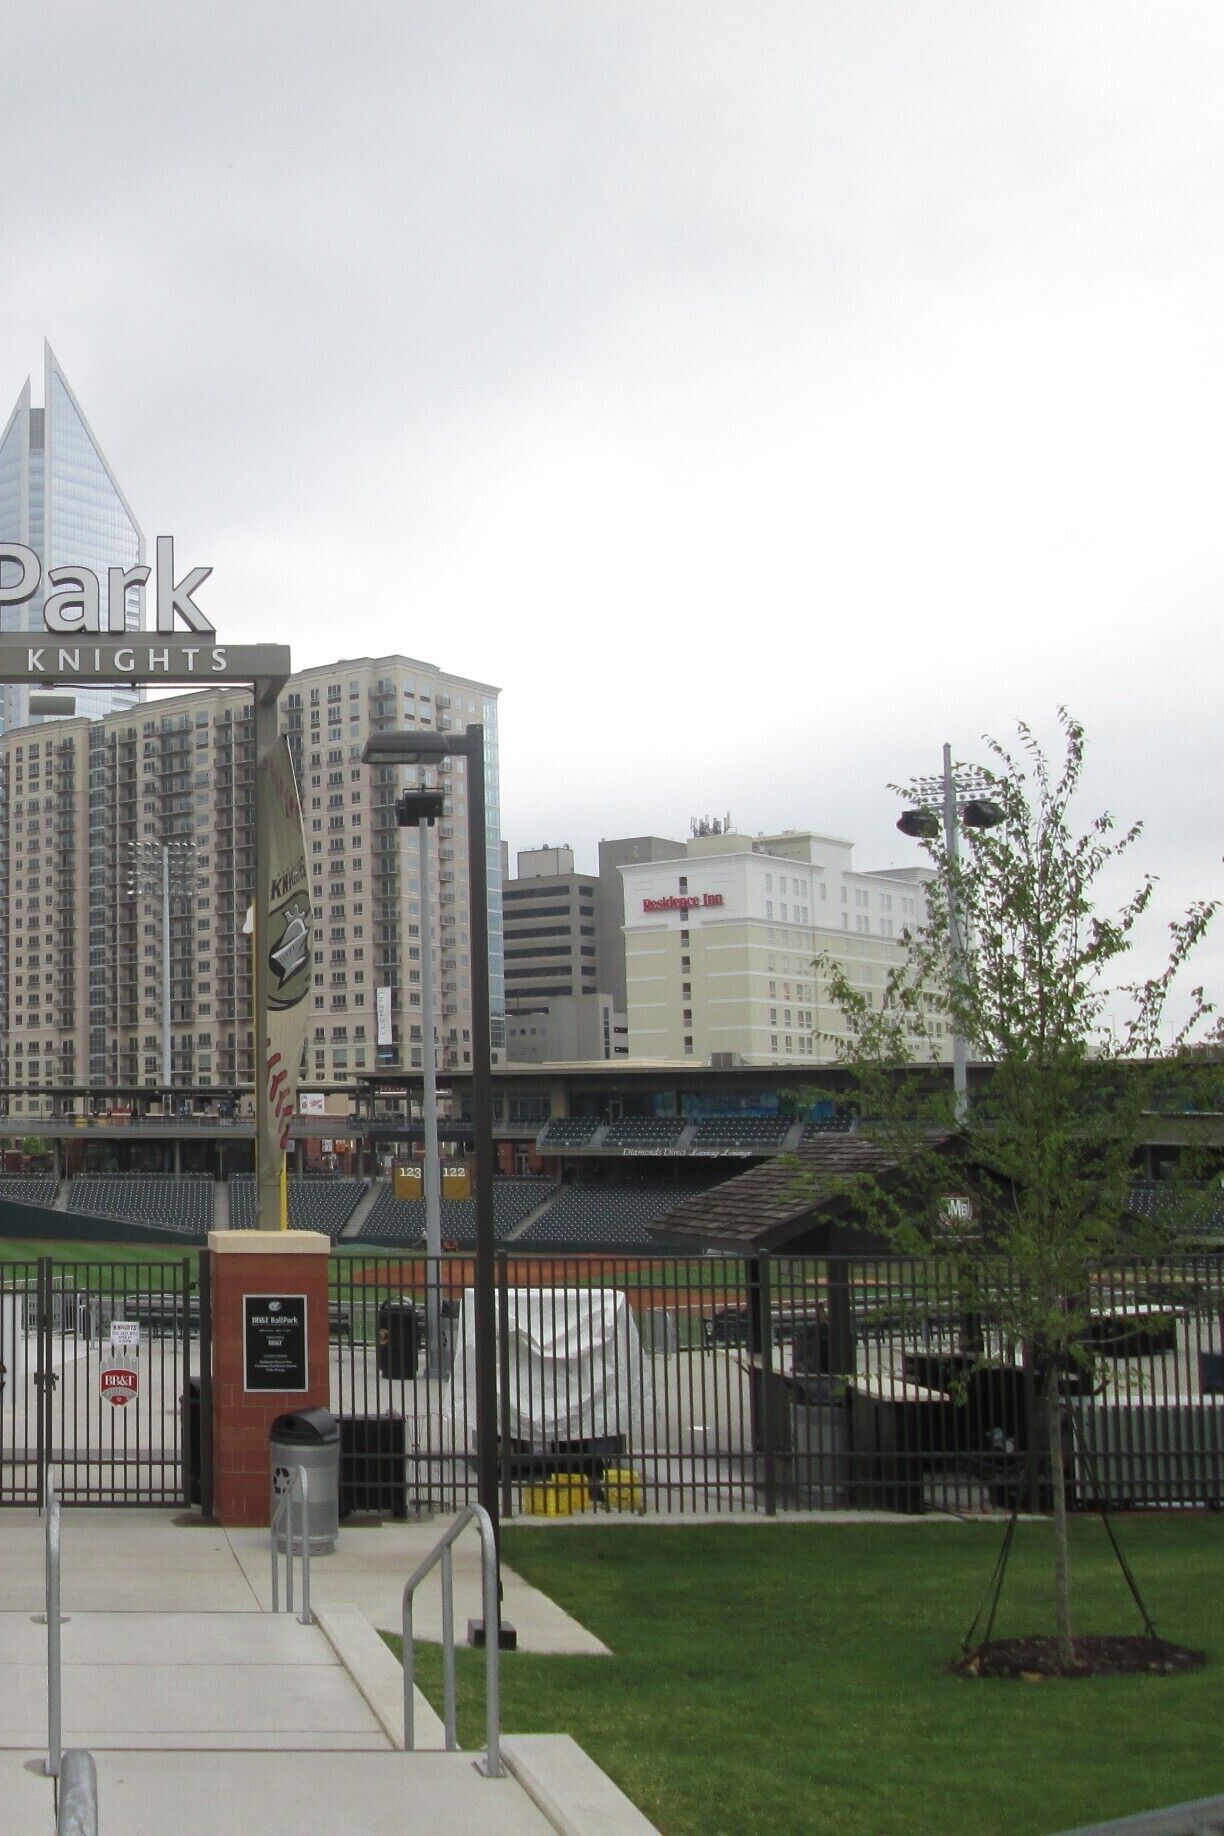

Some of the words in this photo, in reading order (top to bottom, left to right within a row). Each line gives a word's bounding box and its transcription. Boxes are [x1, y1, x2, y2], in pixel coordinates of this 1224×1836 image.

[28, 648, 228, 673] KNIGHTS
[643, 896, 699, 912] Residence
[703, 893, 724, 907] Inn
[622, 1147, 662, 1156] Diamonds
[400, 1167, 422, 1179] 123
[443, 1167, 466, 1177] 122
[104, 1375, 135, 1387] BB&T
